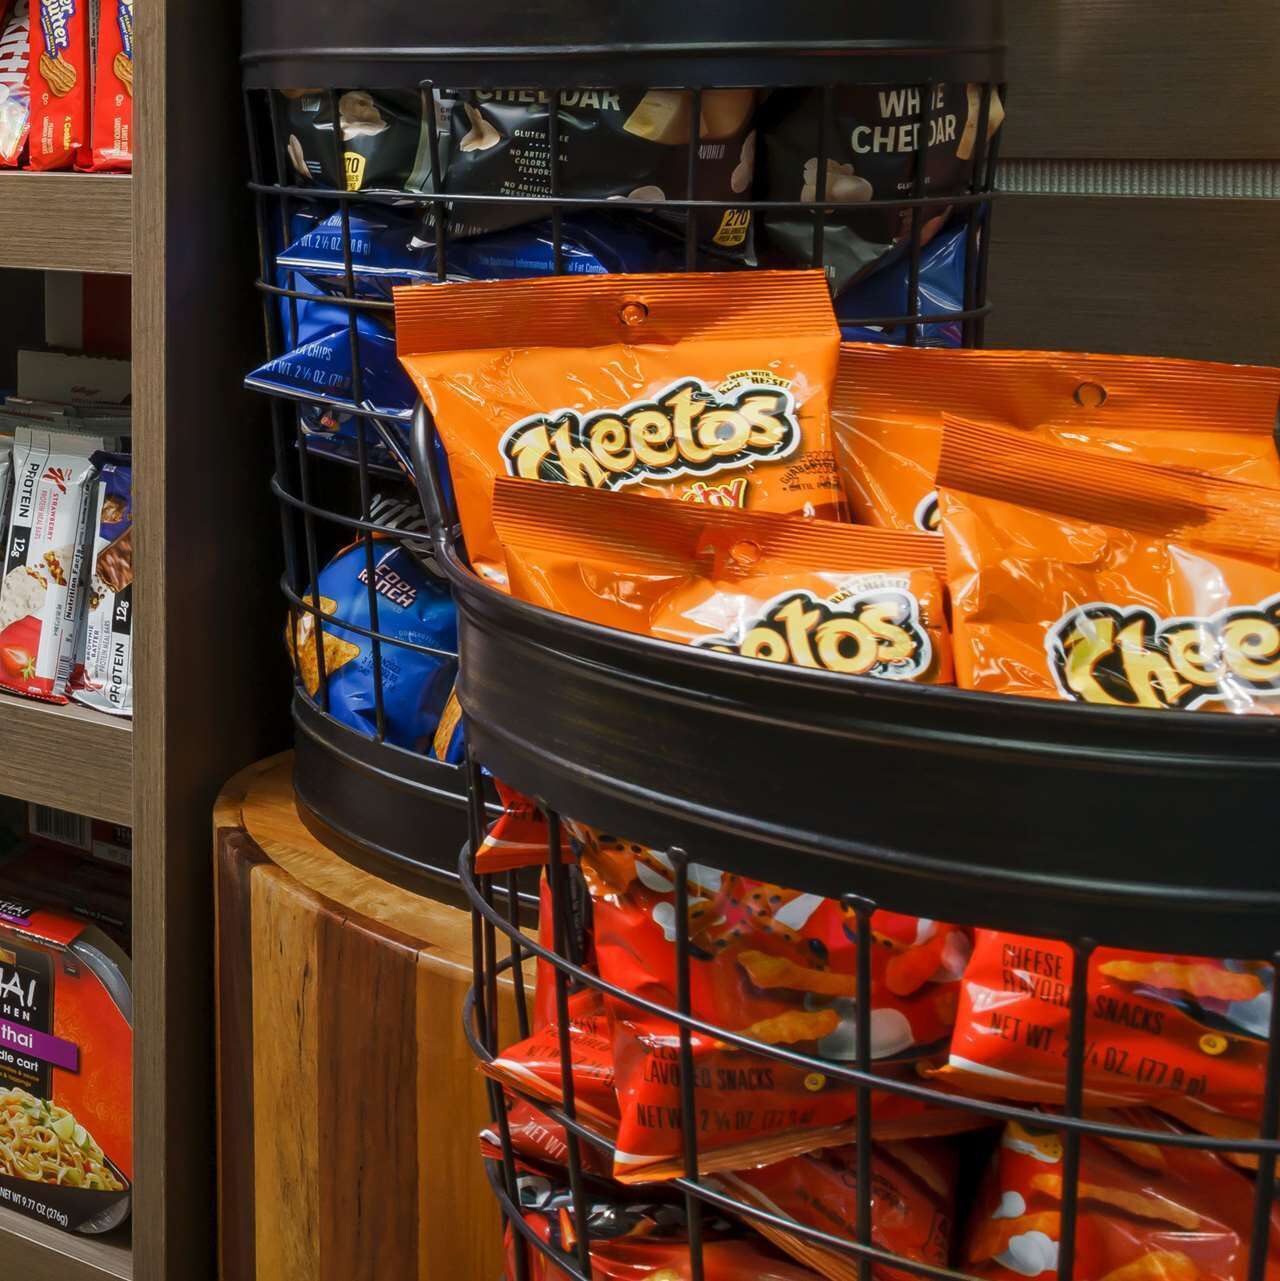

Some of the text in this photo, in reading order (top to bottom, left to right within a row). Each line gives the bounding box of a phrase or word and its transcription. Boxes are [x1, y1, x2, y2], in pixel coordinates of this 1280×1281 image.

[514, 129, 546, 139] GLUTEN
[515, 158, 547, 167] COLORS
[725, 209, 748, 226] 270
[509, 381, 789, 488] Cheetos
[18, 463, 40, 518] PROTEIN
[11, 536, 26, 558] 12g
[66, 548, 82, 619] Nutrition Facts
[376, 563, 417, 597] COOL
[116, 600, 129, 622] 12g
[1002, 944, 1064, 980] CHEESE
[1095, 994, 1165, 1035] SNACKS
[2, 1023, 33, 1048] thai
[991, 1012, 1056, 1053] NET WT.
[17, 1054, 39, 1072] cart
[546, 1134, 567, 1157] WT
[0, 1187, 68, 1227] NET WT 9.77 OZ (276g)
